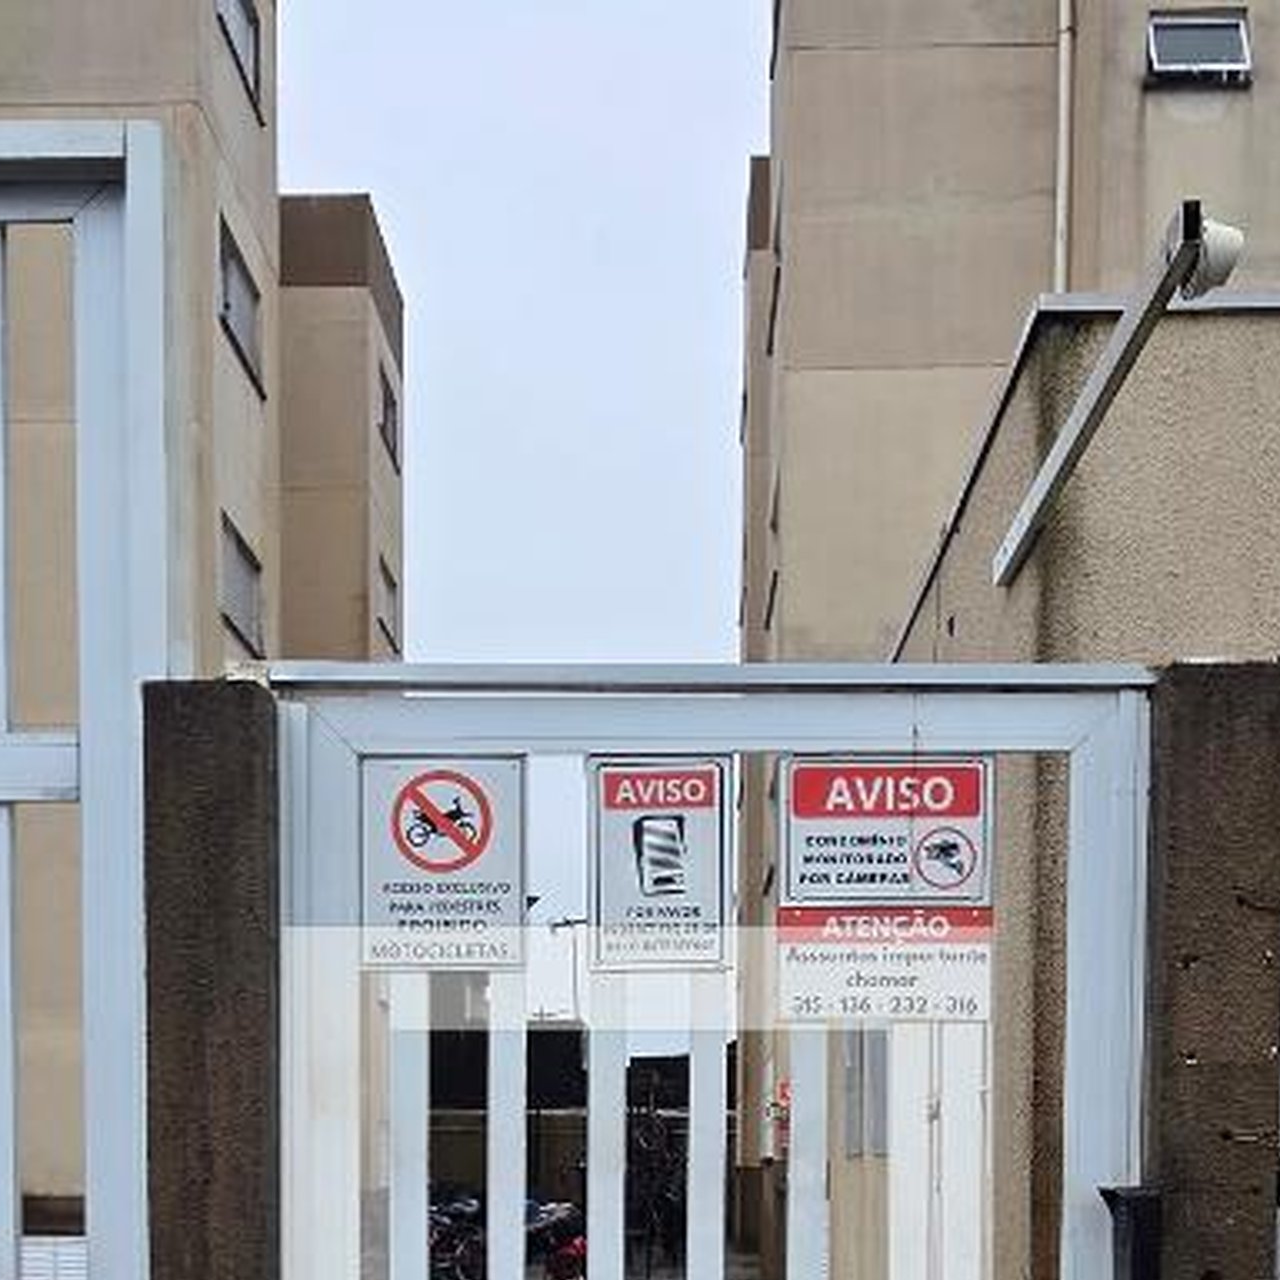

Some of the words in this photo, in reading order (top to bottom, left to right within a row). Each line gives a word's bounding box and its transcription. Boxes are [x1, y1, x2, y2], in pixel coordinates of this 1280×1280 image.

[615, 778, 708, 805] AVISO
[825, 776, 955, 811] AVISO
[822, 909, 952, 945] ATENÇÃO
